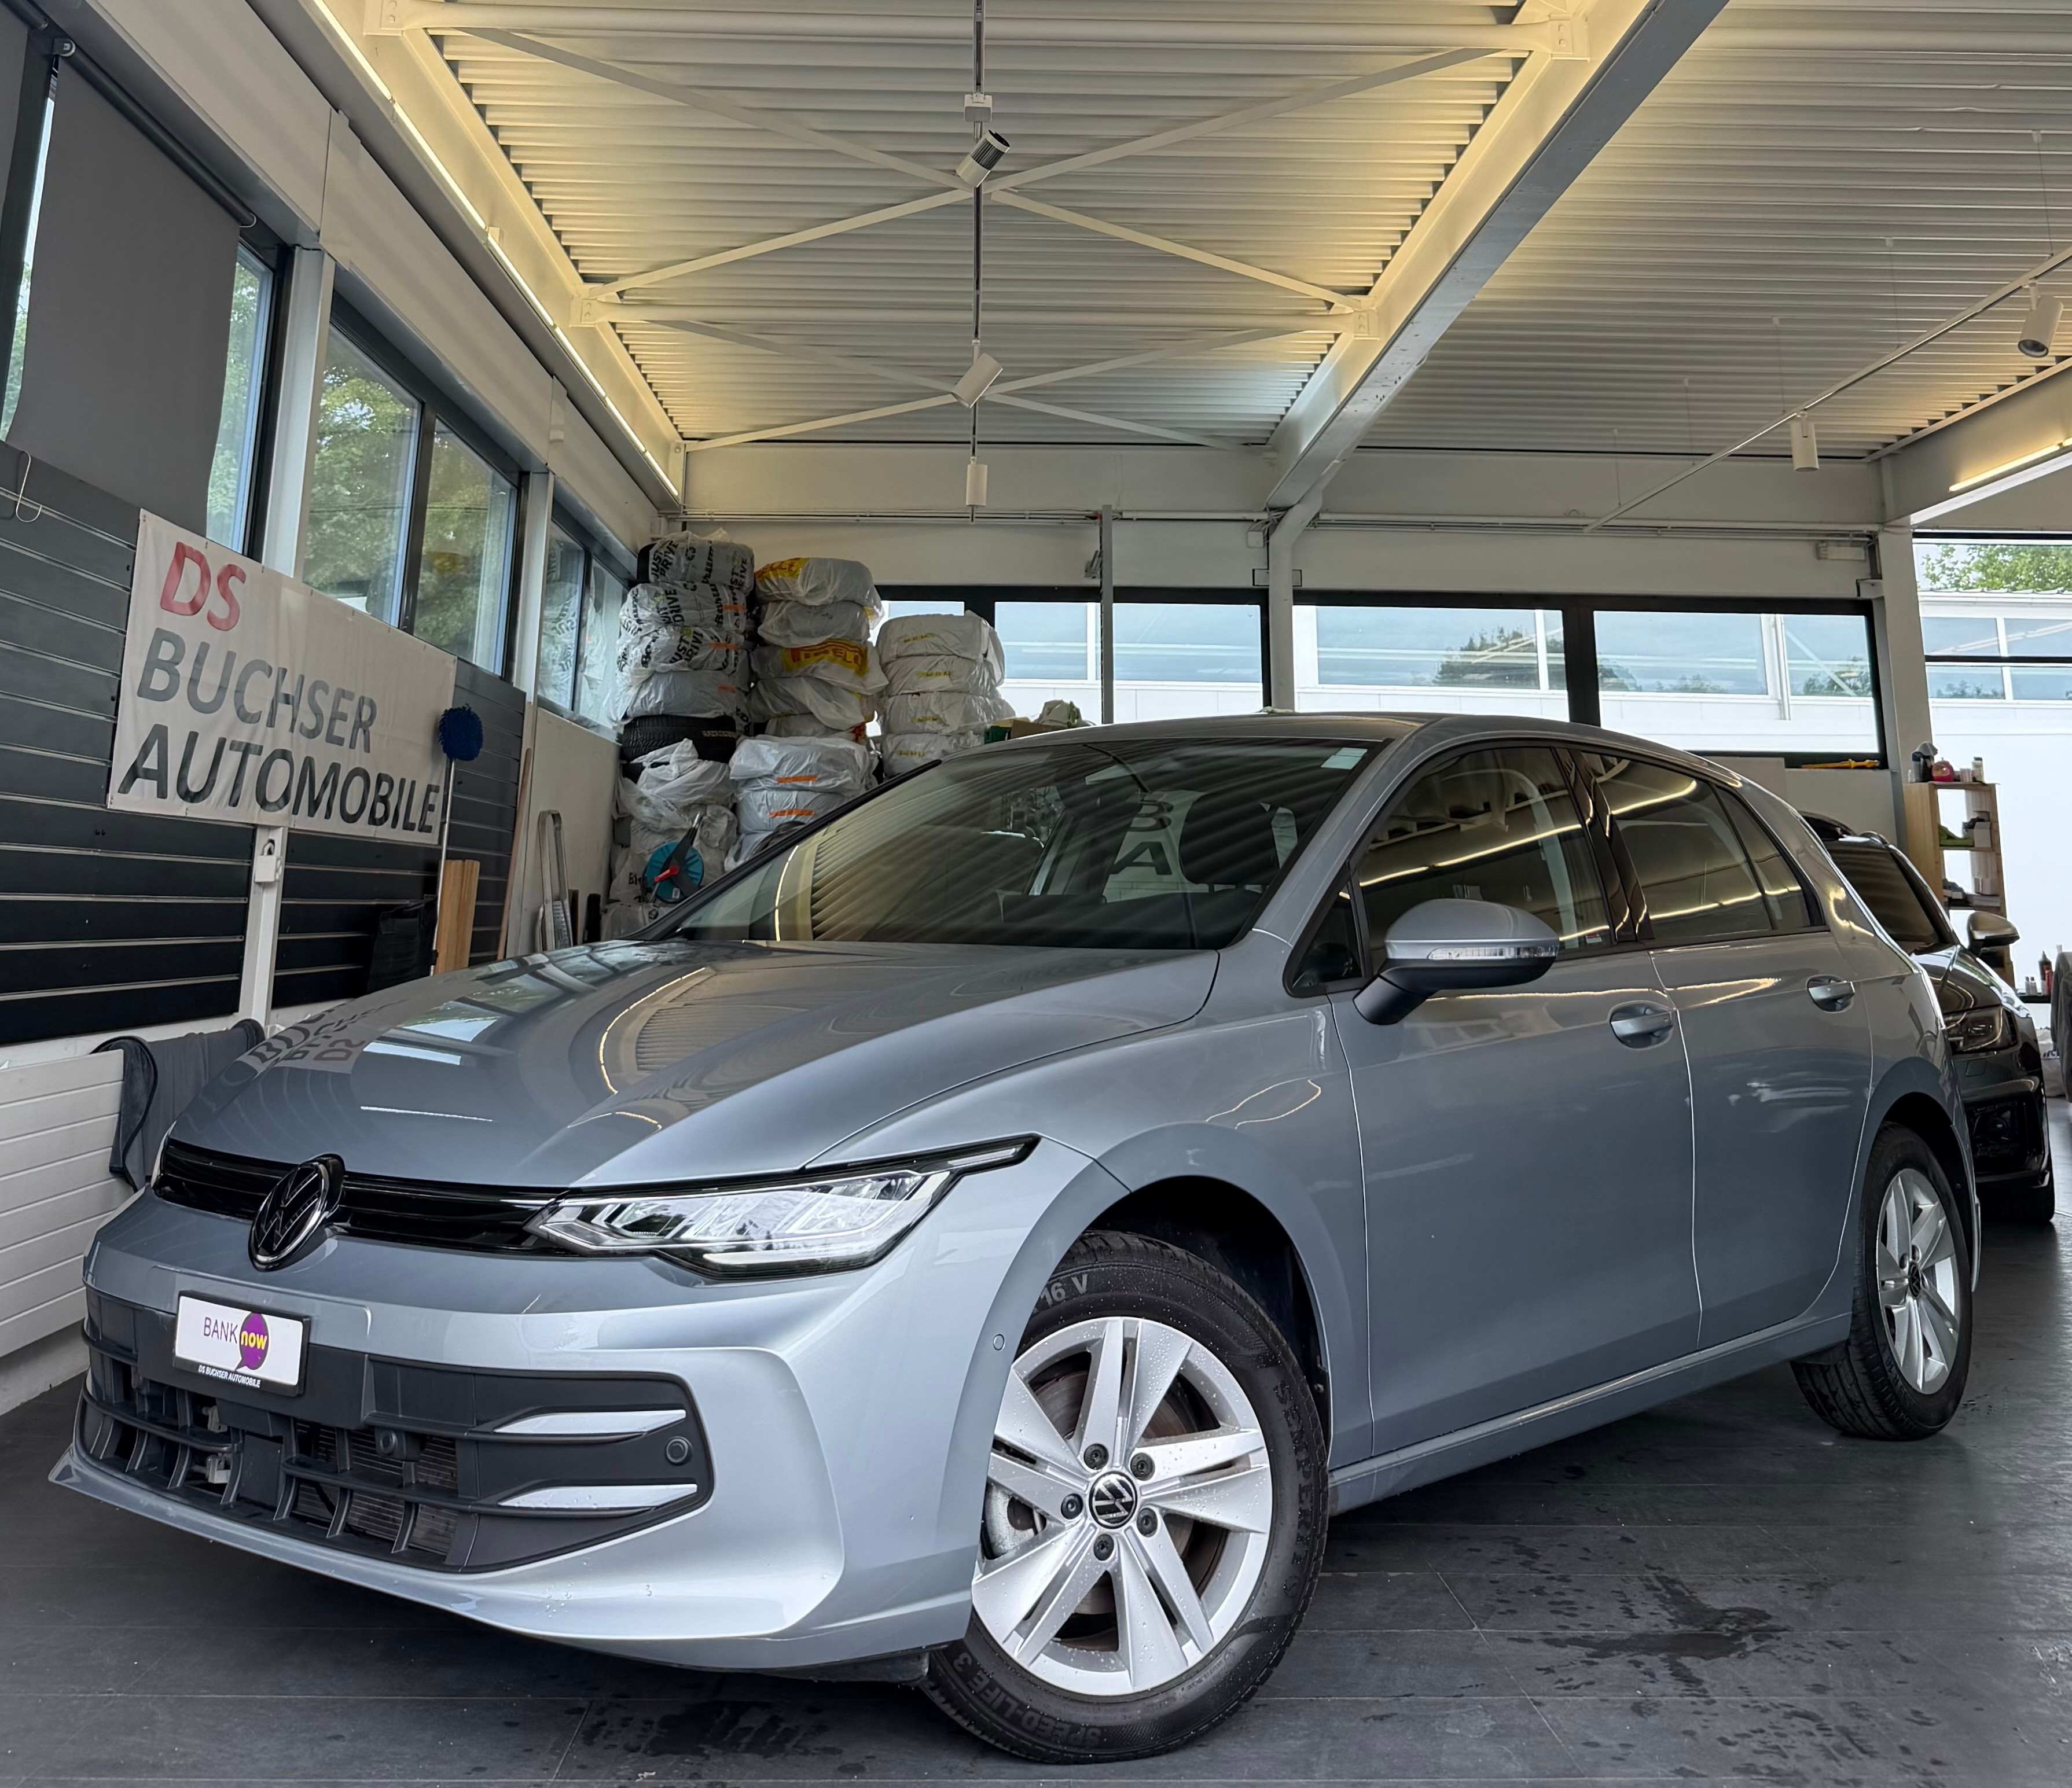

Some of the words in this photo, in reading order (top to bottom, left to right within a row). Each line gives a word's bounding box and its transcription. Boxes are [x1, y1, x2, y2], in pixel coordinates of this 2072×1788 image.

[160, 542, 246, 631] DS
[137, 627, 377, 753] BUCHSER
[118, 724, 440, 833] AUTOMOBILE
[1071, 1274, 1088, 1295] V
[204, 1317, 238, 1344] BANK
[241, 1331, 267, 1350] now
[198, 1364, 205, 1374] DS
[205, 1366, 228, 1379] BUCHSER
[228, 1373, 261, 1388] AUTOMOBILE
[1273, 1380, 1313, 1563] SEMPERIT
[953, 1652, 972, 1672] 3
[969, 1672, 1103, 1748] SPEED-LIFE
